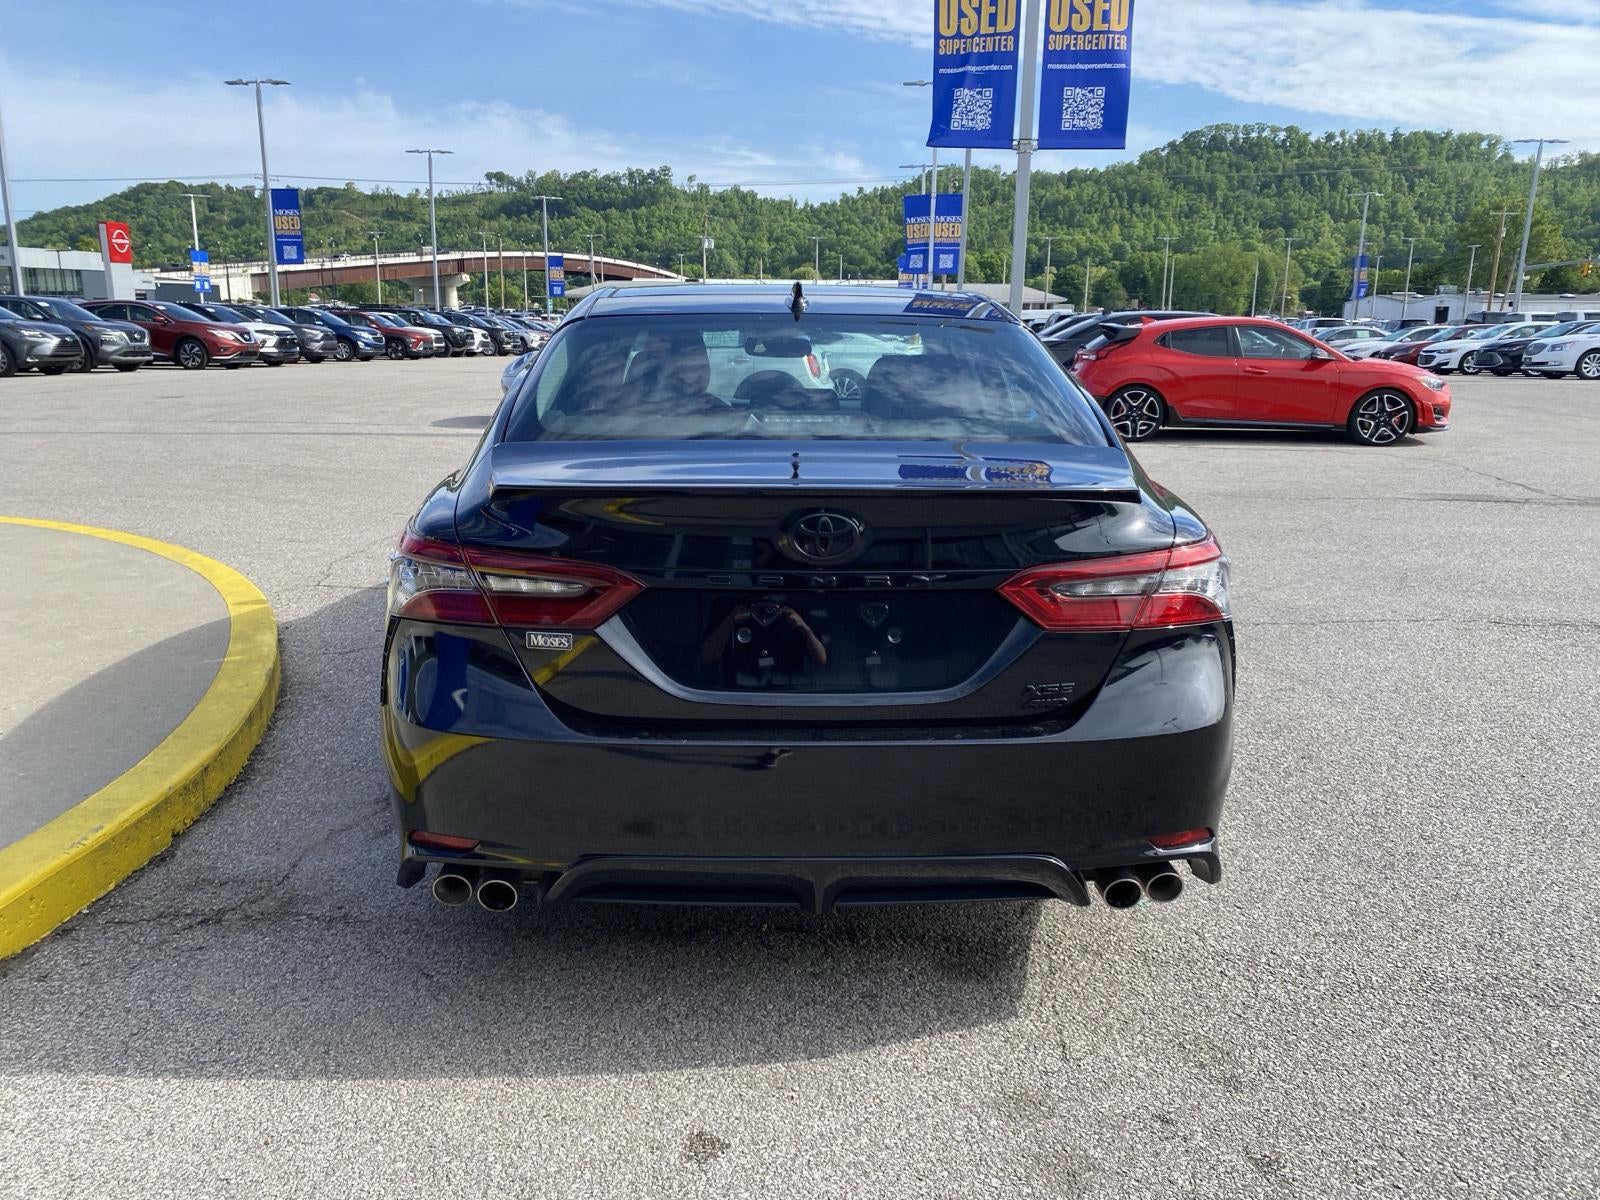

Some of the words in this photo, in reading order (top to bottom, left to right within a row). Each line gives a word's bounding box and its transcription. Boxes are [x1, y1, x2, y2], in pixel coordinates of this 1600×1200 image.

[939, 0, 1017, 37] USED
[1050, 0, 1130, 32] USED
[939, 36, 1014, 55] SUPERCENTER
[1048, 34, 1127, 50] SUPERCENTER
[1047, 62, 1127, 71] mosesusedsupercenter.com
[274, 208, 300, 216] MOSES
[935, 215, 962, 223] MOSES
[275, 215, 301, 230] USED
[934, 222, 961, 238] USED
[906, 223, 930, 239] USED
[530, 634, 569, 648] MOSES
